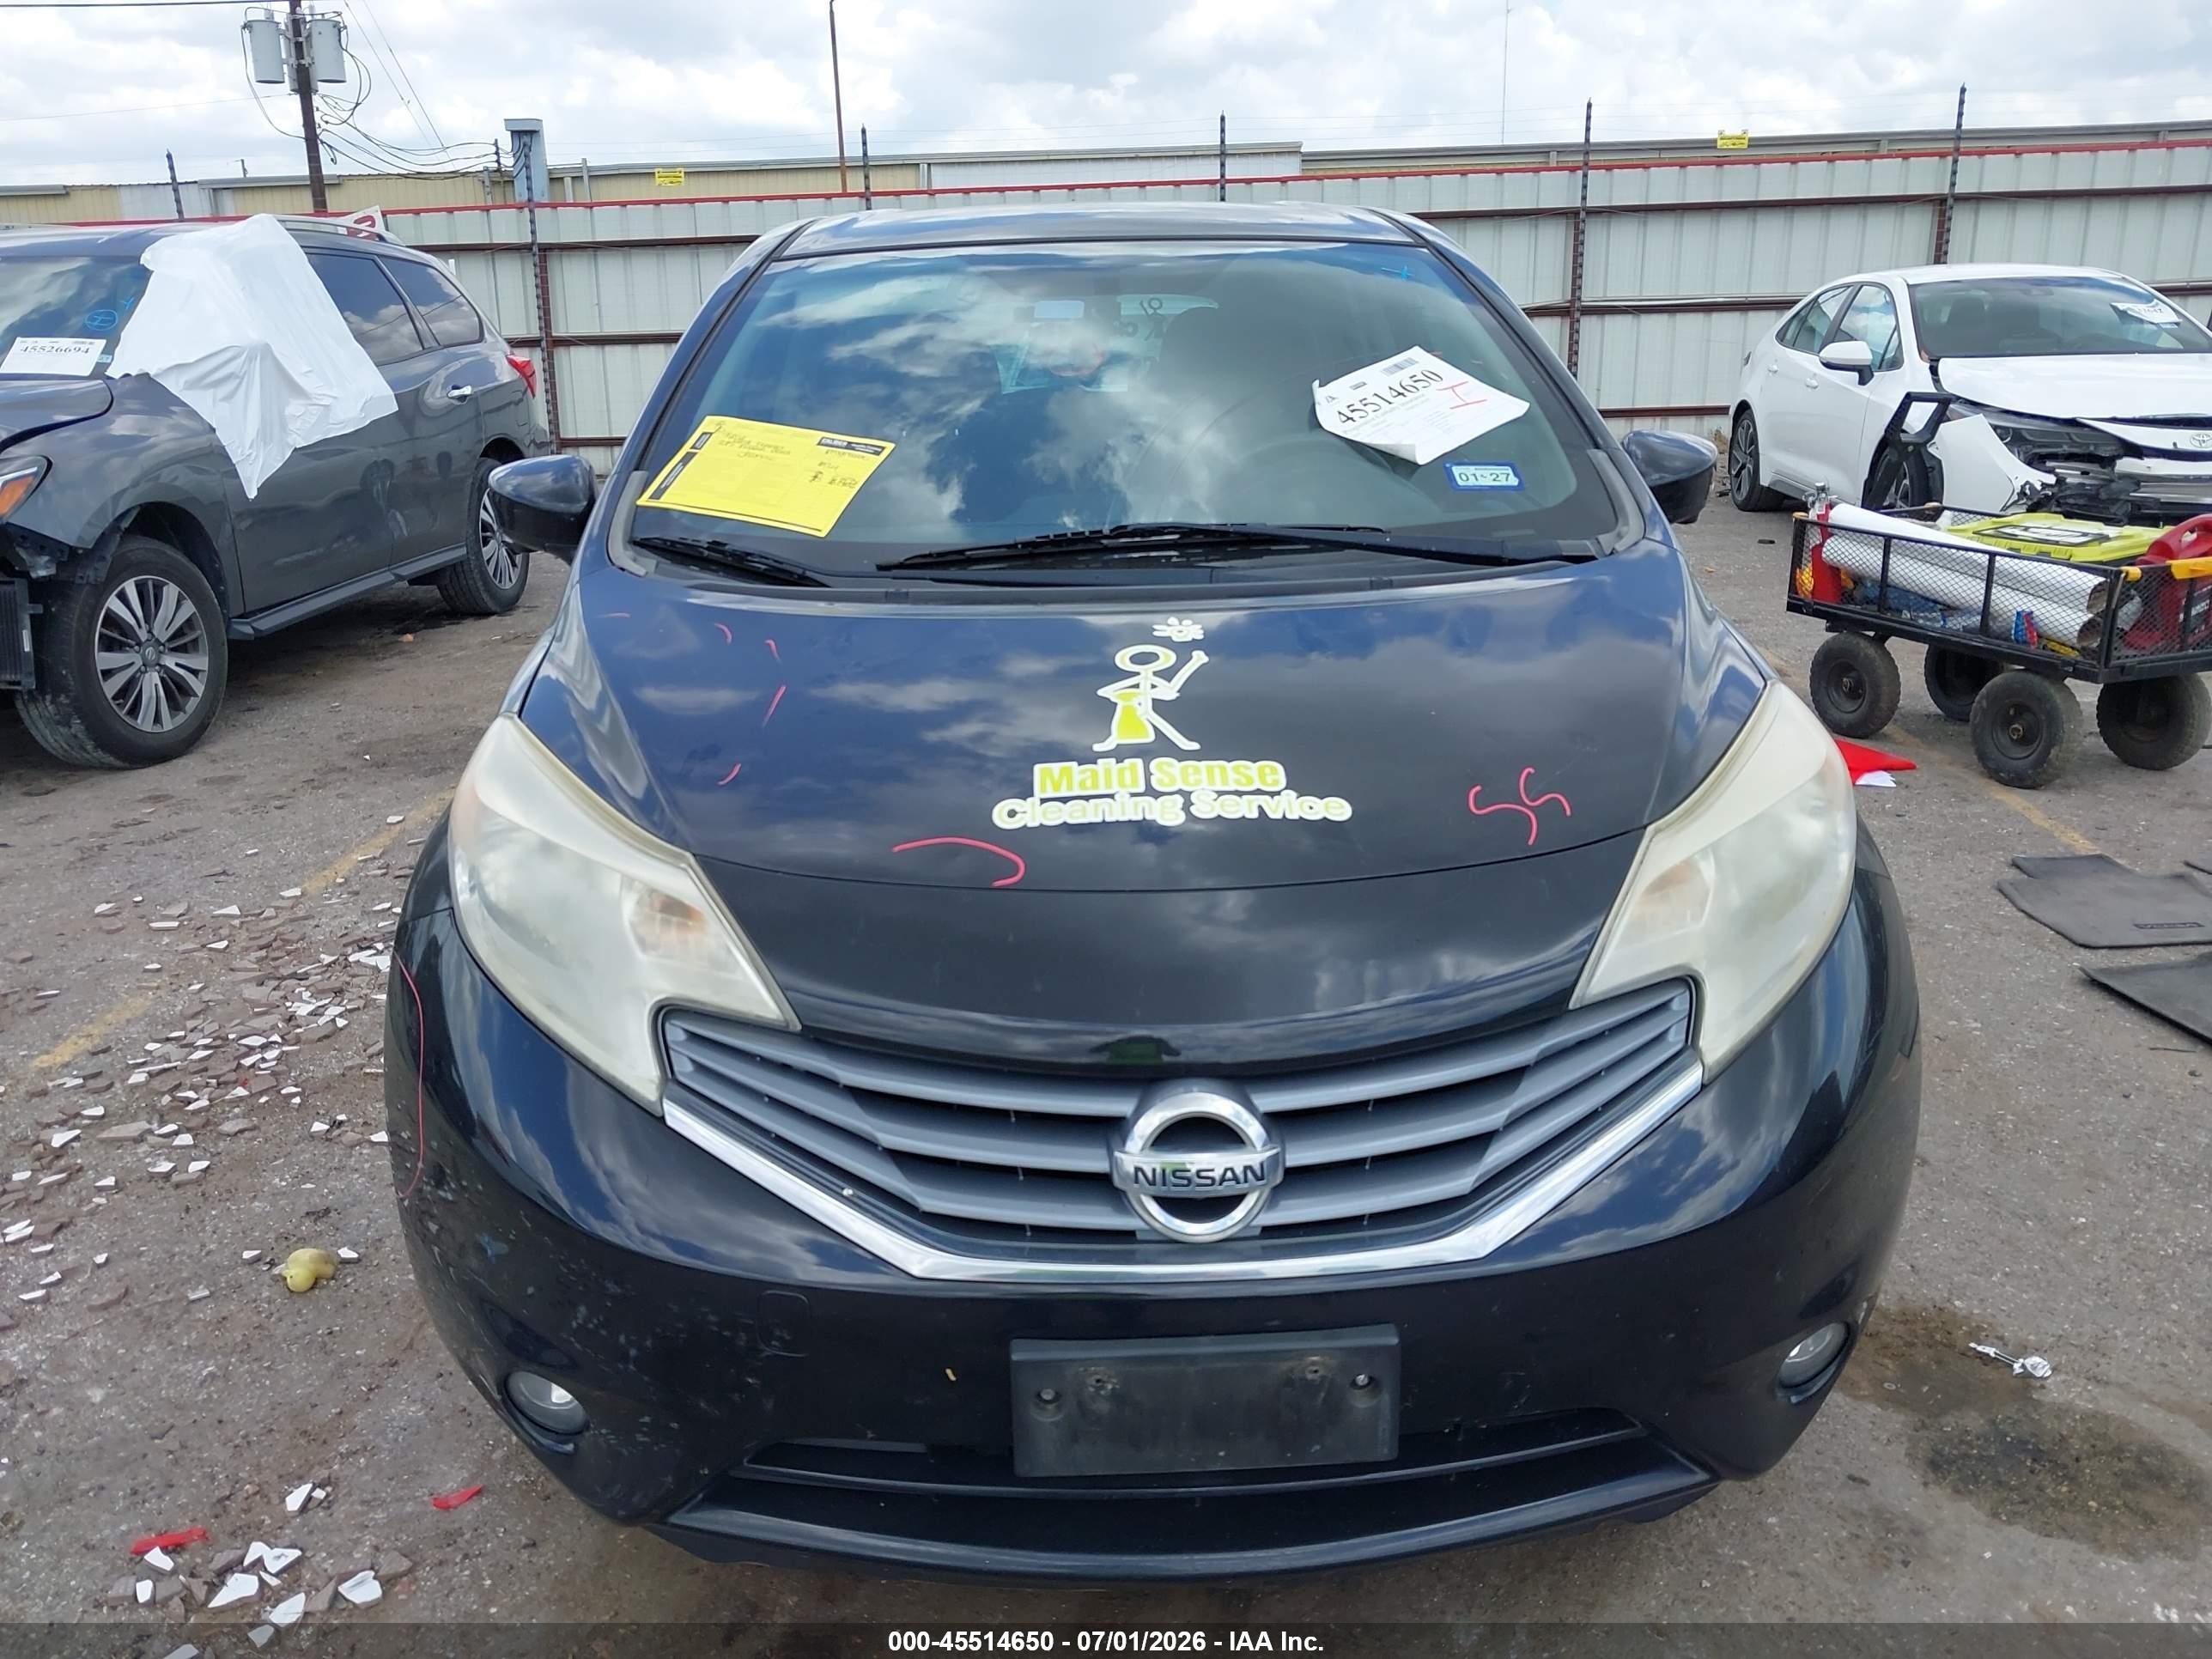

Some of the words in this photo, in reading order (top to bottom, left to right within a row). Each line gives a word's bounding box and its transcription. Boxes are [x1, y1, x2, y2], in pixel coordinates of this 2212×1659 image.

[20, 345, 90, 354] 45526694
[1337, 369, 1443, 423] 45514650
[1035, 759, 1145, 797] Maid
[1150, 757, 1285, 792] Sense
[993, 792, 1185, 829] Cleaning
[1190, 789, 1352, 821] Service
[1133, 1161, 1266, 1188] NISSAN
